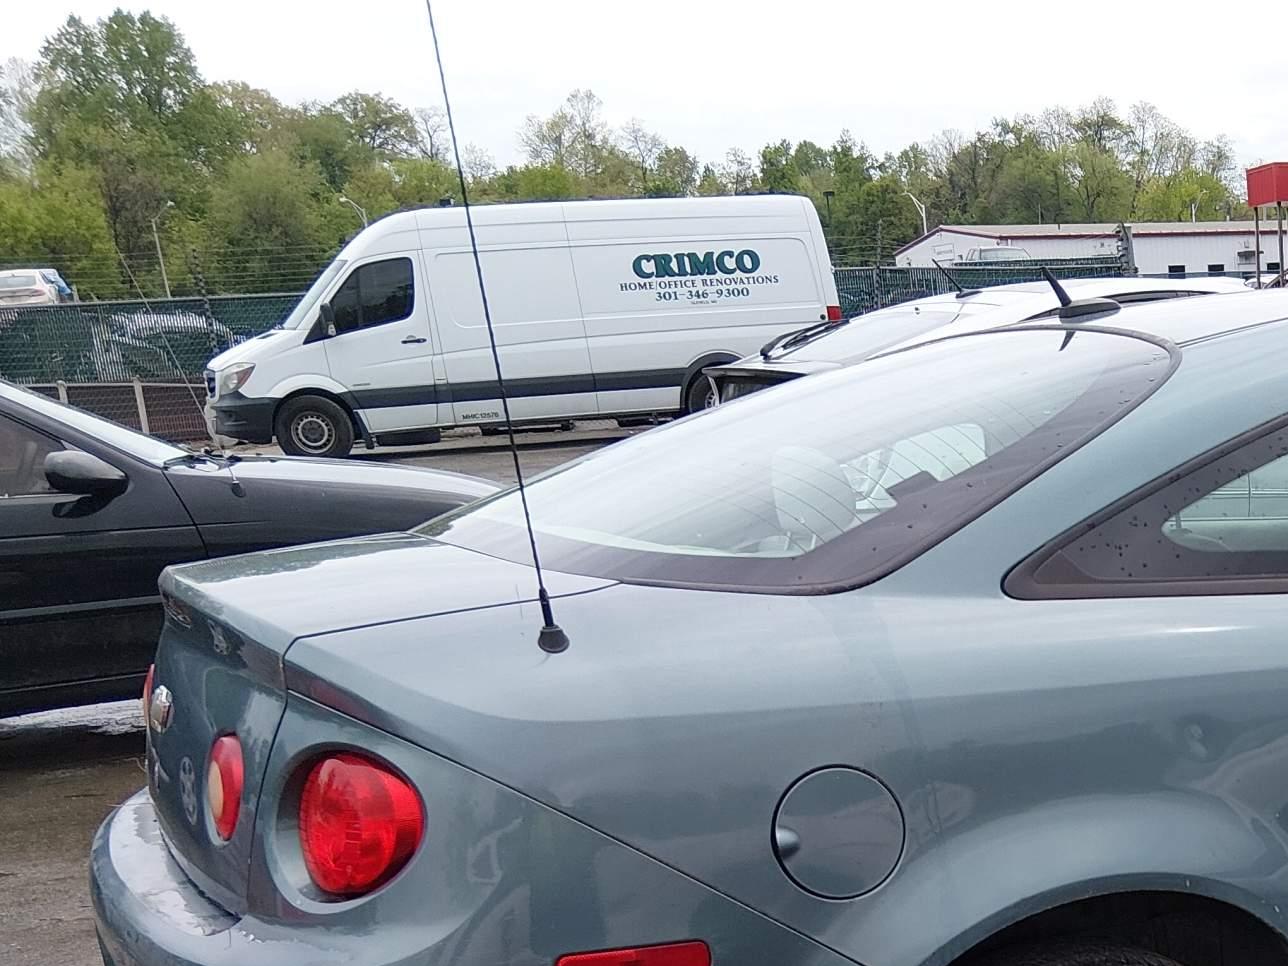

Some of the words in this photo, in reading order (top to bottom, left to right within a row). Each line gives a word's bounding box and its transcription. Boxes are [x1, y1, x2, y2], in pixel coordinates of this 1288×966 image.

[633, 250, 760, 279] CRIMCO
[620, 280, 697, 291] HOME/OFFICE
[701, 275, 779, 287] RENOVATIONS
[656, 287, 750, 301] 301-346-9300
